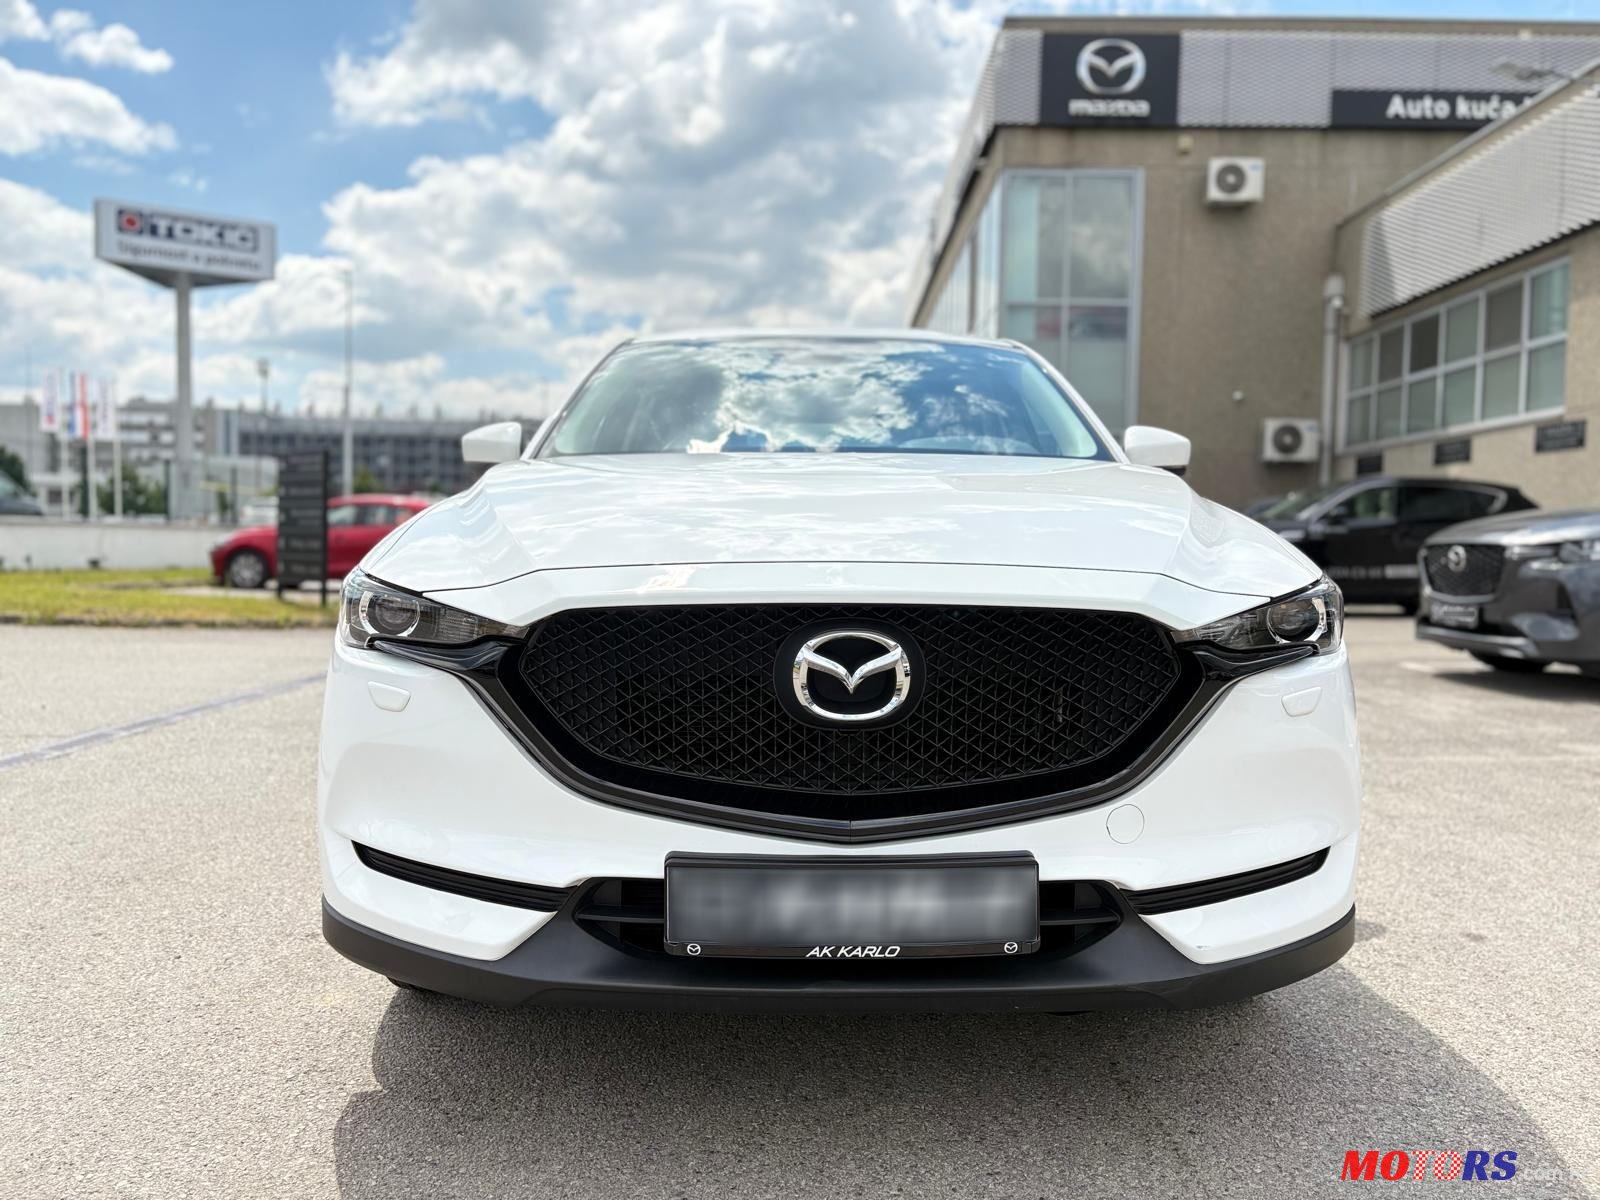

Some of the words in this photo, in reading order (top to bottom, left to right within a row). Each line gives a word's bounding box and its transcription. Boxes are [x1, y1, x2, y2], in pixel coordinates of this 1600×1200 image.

[1385, 93, 1451, 119] Auto
[805, 945, 836, 958] AK
[836, 945, 901, 958] KARLO
